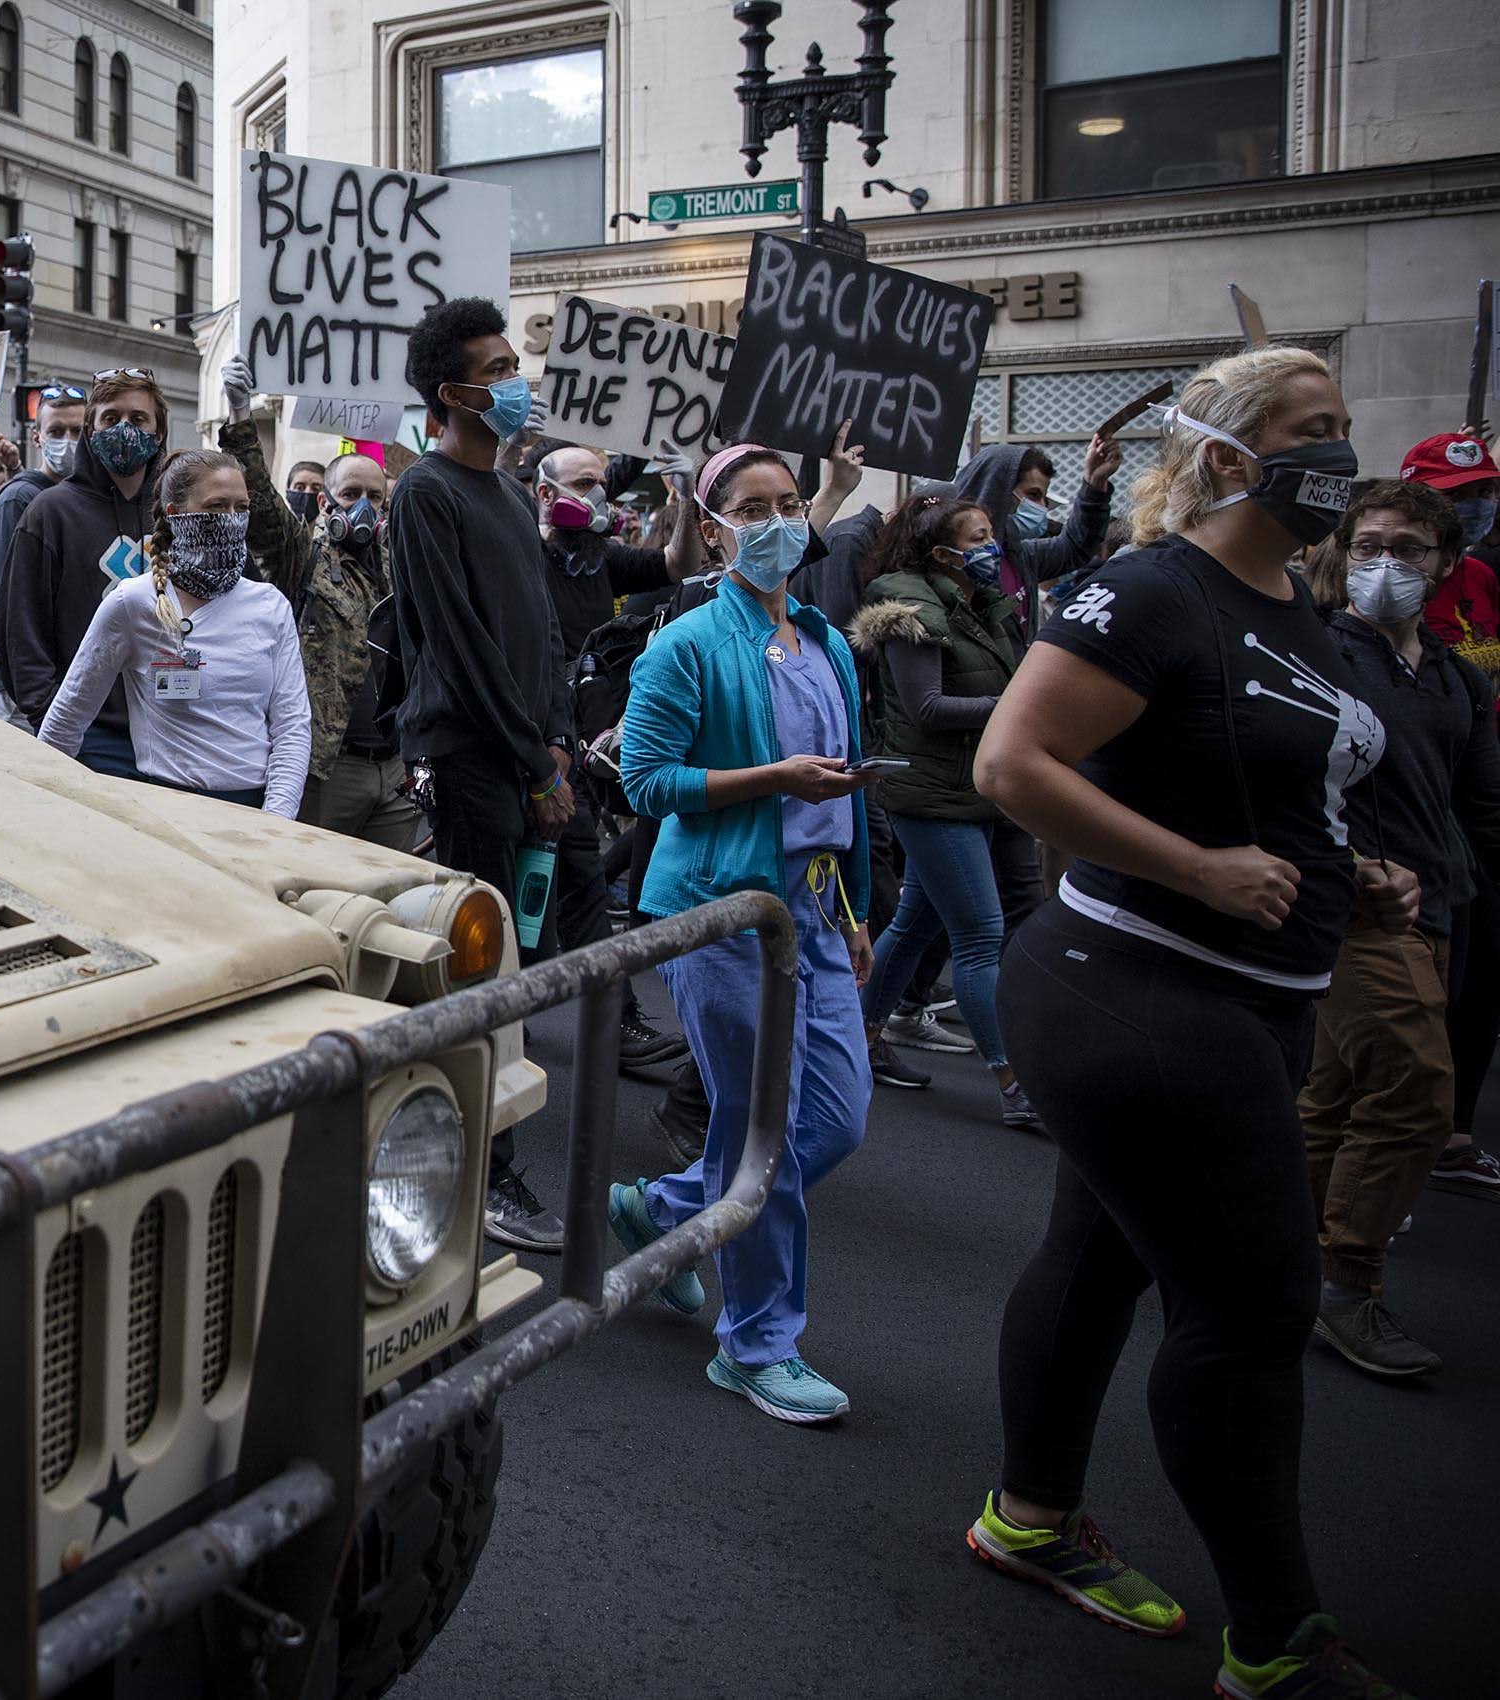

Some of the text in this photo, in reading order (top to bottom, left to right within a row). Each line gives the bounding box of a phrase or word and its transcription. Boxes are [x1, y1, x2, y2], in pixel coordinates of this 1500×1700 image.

[250, 150, 449, 249] BLACK
[683, 187, 793, 217] TREMONT ST
[268, 238, 447, 310] LIVES
[750, 236, 892, 345] BLACK
[895, 282, 981, 374] LIVES
[250, 312, 414, 388] MATT
[308, 400, 381, 431] MATTER
[544, 365, 628, 426] THE
[738, 342, 943, 456] MATTER
[1306, 474, 1328, 488] NO
[1307, 489, 1331, 504] NO
[366, 1301, 449, 1376] TIE-DOWN
